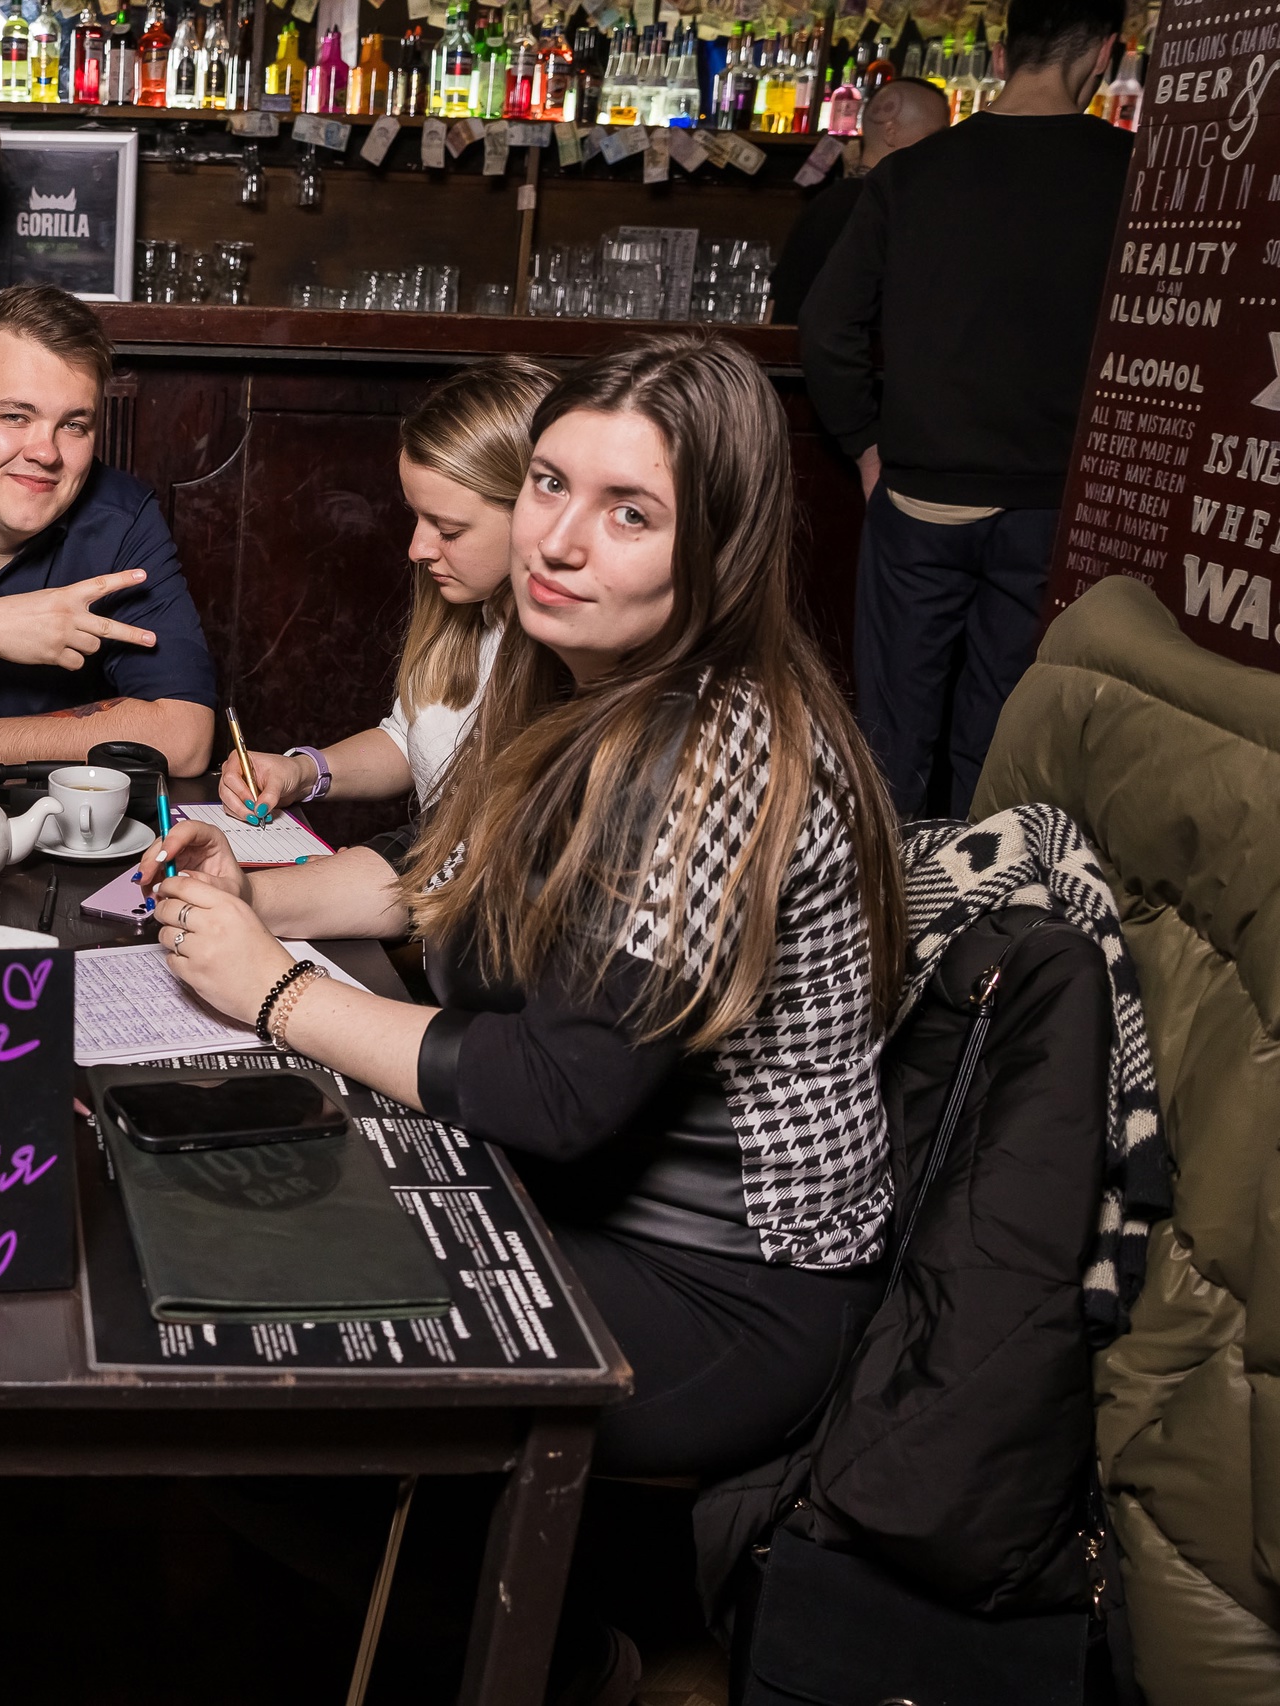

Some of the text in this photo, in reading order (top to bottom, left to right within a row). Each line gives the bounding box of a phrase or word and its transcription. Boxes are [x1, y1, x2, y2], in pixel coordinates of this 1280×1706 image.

[1159, 33, 1228, 68] RELIGIONS
[1154, 66, 1233, 104] BEER
[1146, 113, 1220, 169] Wine
[1131, 163, 1256, 212] REMAIN
[16, 211, 90, 238] GORILLA
[1120, 240, 1238, 276] REALITY
[1156, 280, 1184, 297] IS AN
[1109, 293, 1222, 328] ILLUSION
[1099, 351, 1205, 394] ALCOHOL
[1090, 405, 1196, 440] ALL THE MISTAKES
[1086, 431, 1190, 467] I'VE EVER MADE IN
[1202, 432, 1240, 475] IS
[1080, 454, 1099, 474] MY
[1124, 463, 1153, 486] HAVE
[1153, 469, 1187, 494] BEEN
[1084, 481, 1170, 518] WHEN I'VE BEEN
[1114, 513, 1122, 532] I
[1122, 515, 1169, 542] HAVEN'T
[1067, 527, 1168, 570] MADE HARDLY ANY
[1182, 553, 1280, 641] WA
[362, 1122, 376, 1140] СЫРОМ
[243, 1176, 318, 1207] BAR
[410, 1192, 439, 1237] МЕКСИКАНСКИЙ
[503, 1231, 554, 1308] ГОРЯЧИЕ БЛЮДА
